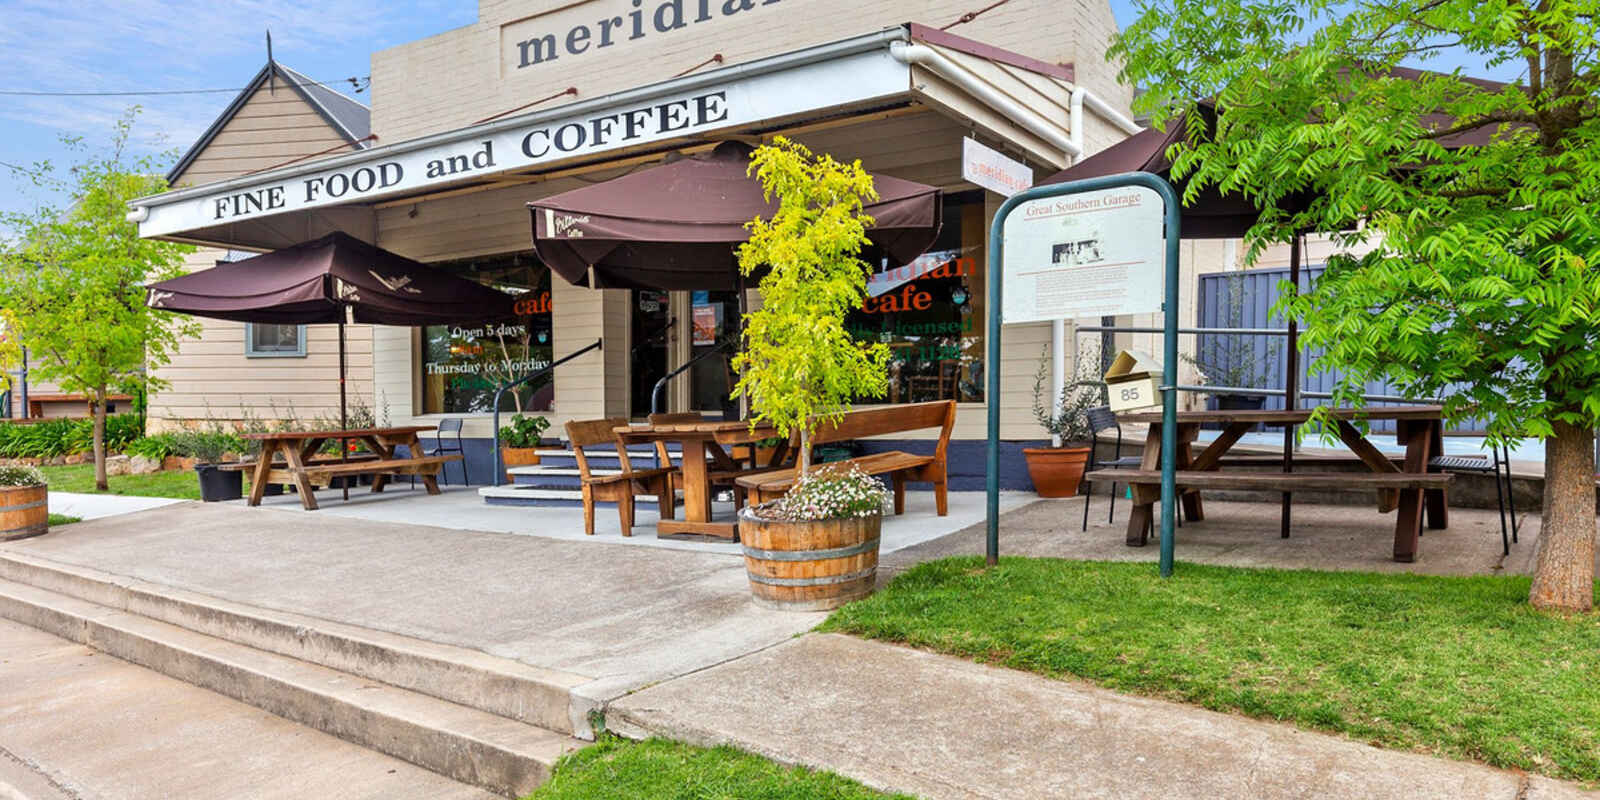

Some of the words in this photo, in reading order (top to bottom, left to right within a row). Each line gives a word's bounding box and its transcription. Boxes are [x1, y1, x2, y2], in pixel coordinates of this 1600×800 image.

[516, 0, 790, 68] meridia
[213, 186, 286, 220] FINE
[304, 162, 404, 202] FOOD
[426, 140, 497, 179] and
[521, 91, 729, 159] COFFEE
[1026, 205, 1053, 217] Great
[1055, 199, 1101, 212] Southern
[1103, 192, 1142, 206] Garage
[862, 283, 933, 314] cafe
[452, 326, 484, 339] Open
[487, 324, 495, 336] 5
[496, 323, 526, 338] days
[425, 360, 481, 376] Thursday
[484, 361, 497, 373] to
[501, 356, 551, 372] Monday
[1121, 388, 1140, 401] 85
